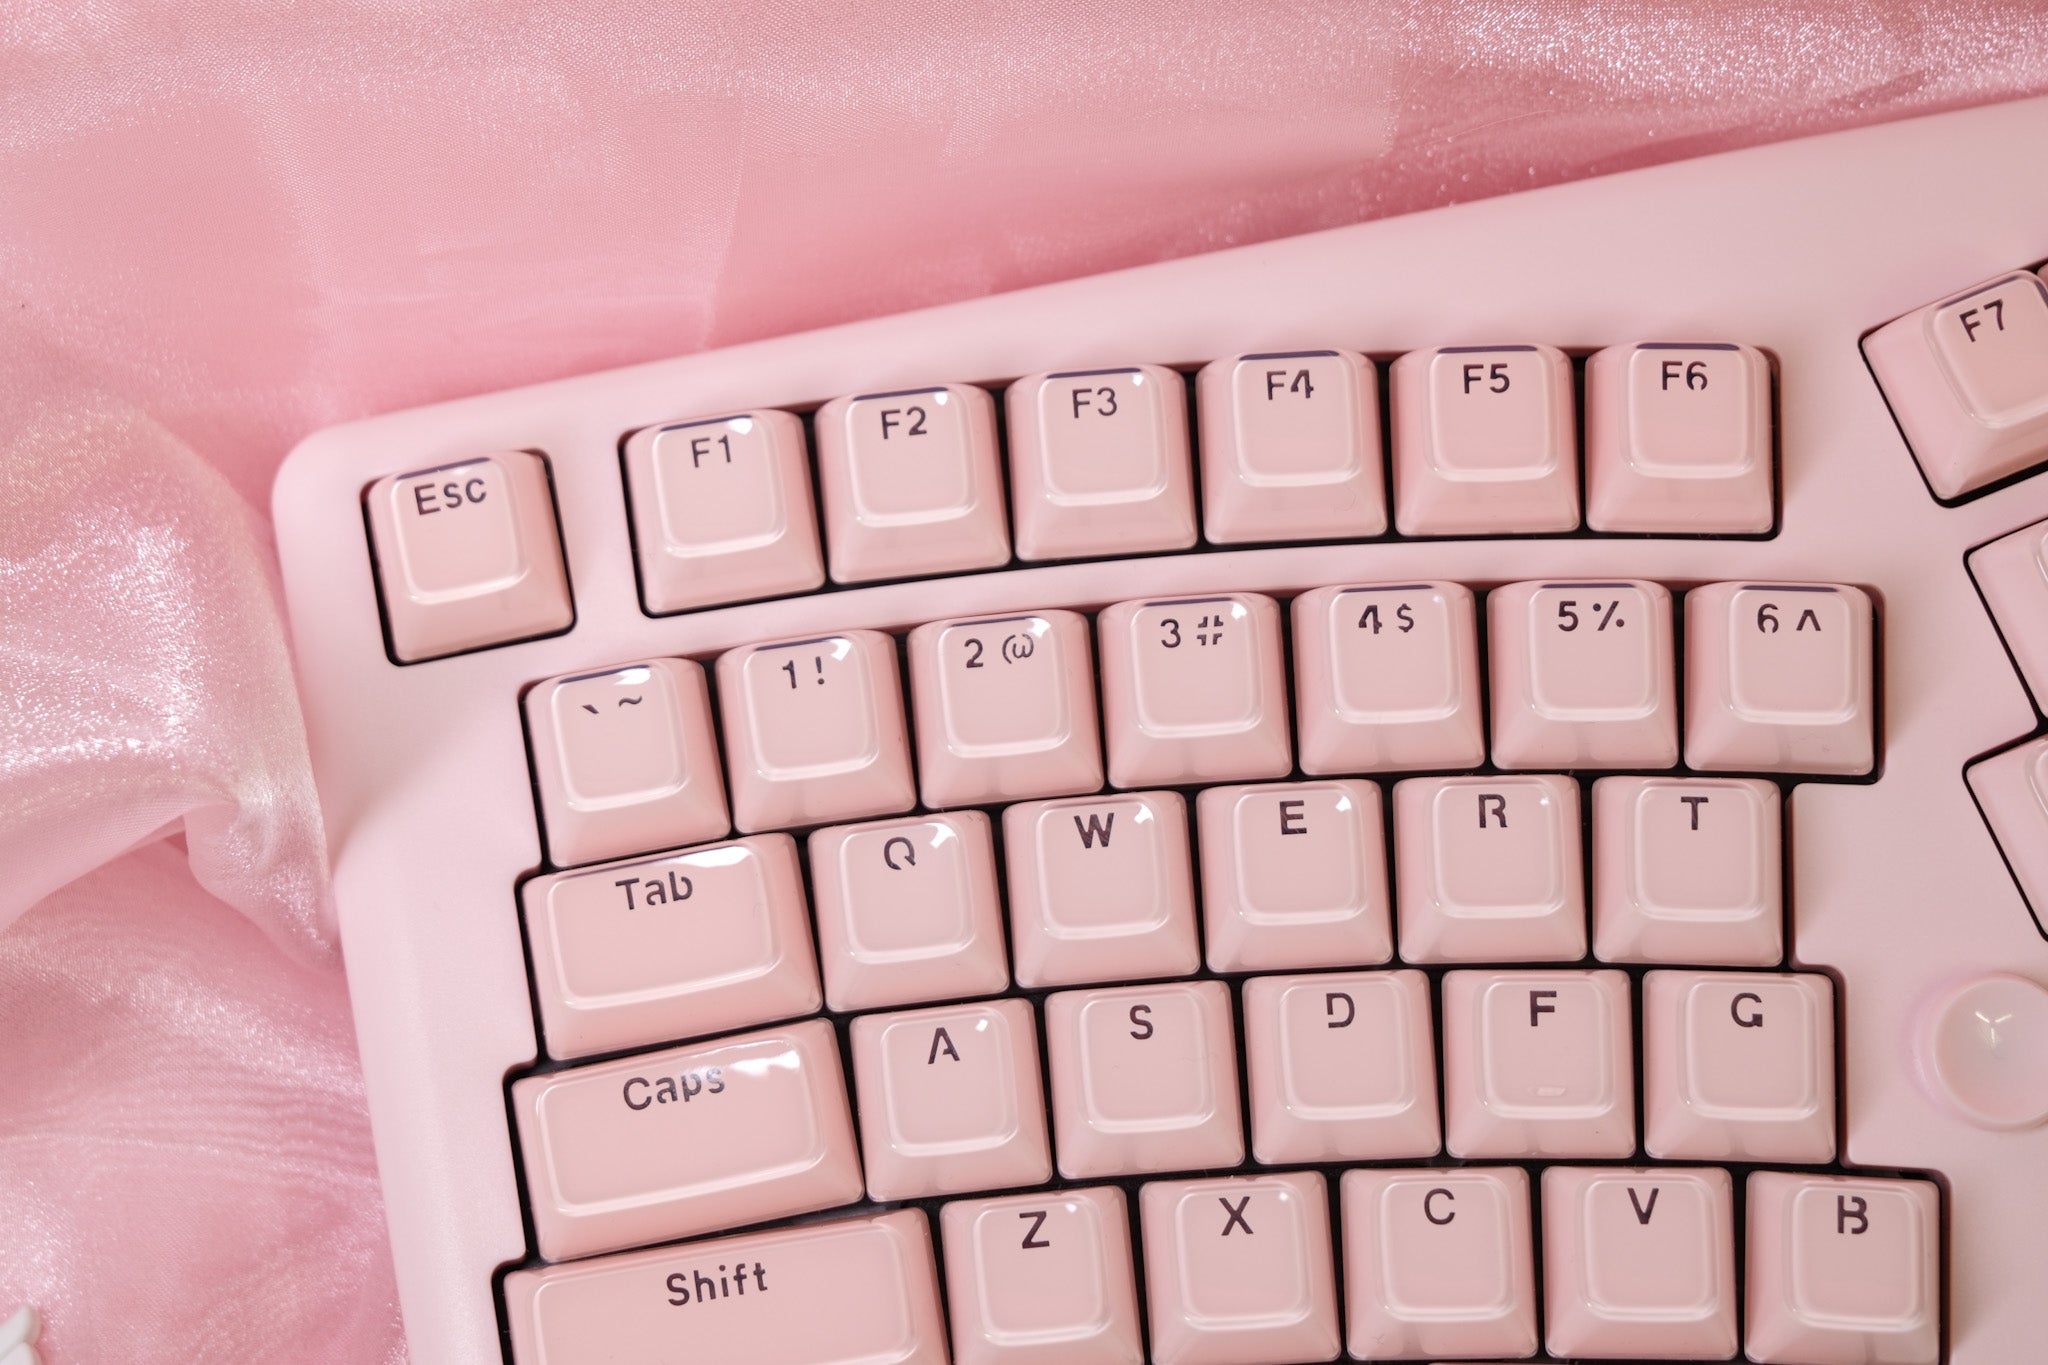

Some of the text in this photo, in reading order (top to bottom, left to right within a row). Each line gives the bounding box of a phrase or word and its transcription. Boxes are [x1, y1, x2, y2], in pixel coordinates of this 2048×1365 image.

[1959, 299, 2007, 342] F7
[1266, 369, 1315, 401] F4
[1462, 362, 1511, 395] F5
[1661, 360, 1708, 391] F6
[1071, 386, 1118, 419] F3
[880, 406, 928, 440] F2
[690, 434, 732, 469] F1
[414, 478, 487, 516] Esc
[1160, 614, 1224, 649] 3 #
[1358, 603, 1415, 635] 4 $
[1557, 600, 1625, 633] 5 %
[1757, 603, 1779, 634] 6
[963, 637, 984, 669] 2
[781, 656, 825, 690] 1 !
[618, 695, 643, 707] ~
[1279, 799, 1308, 836] E
[1478, 793, 1508, 829] R
[1680, 795, 1710, 831] T
[1073, 812, 1115, 850] W
[883, 836, 917, 871] Q
[614, 869, 694, 911] Tab
[1129, 1004, 1154, 1041] S
[1325, 992, 1356, 1029] D
[1529, 990, 1558, 1027] F
[1730, 992, 1764, 1028] G
[927, 1026, 961, 1065] A
[622, 1065, 726, 1112] Caps
[1218, 1195, 1254, 1237] X
[1423, 1187, 1456, 1226] C
[1626, 1187, 1660, 1225] V
[1837, 1194, 1869, 1235] B
[1018, 1210, 1051, 1250] Z
[666, 1262, 768, 1307] Shift
